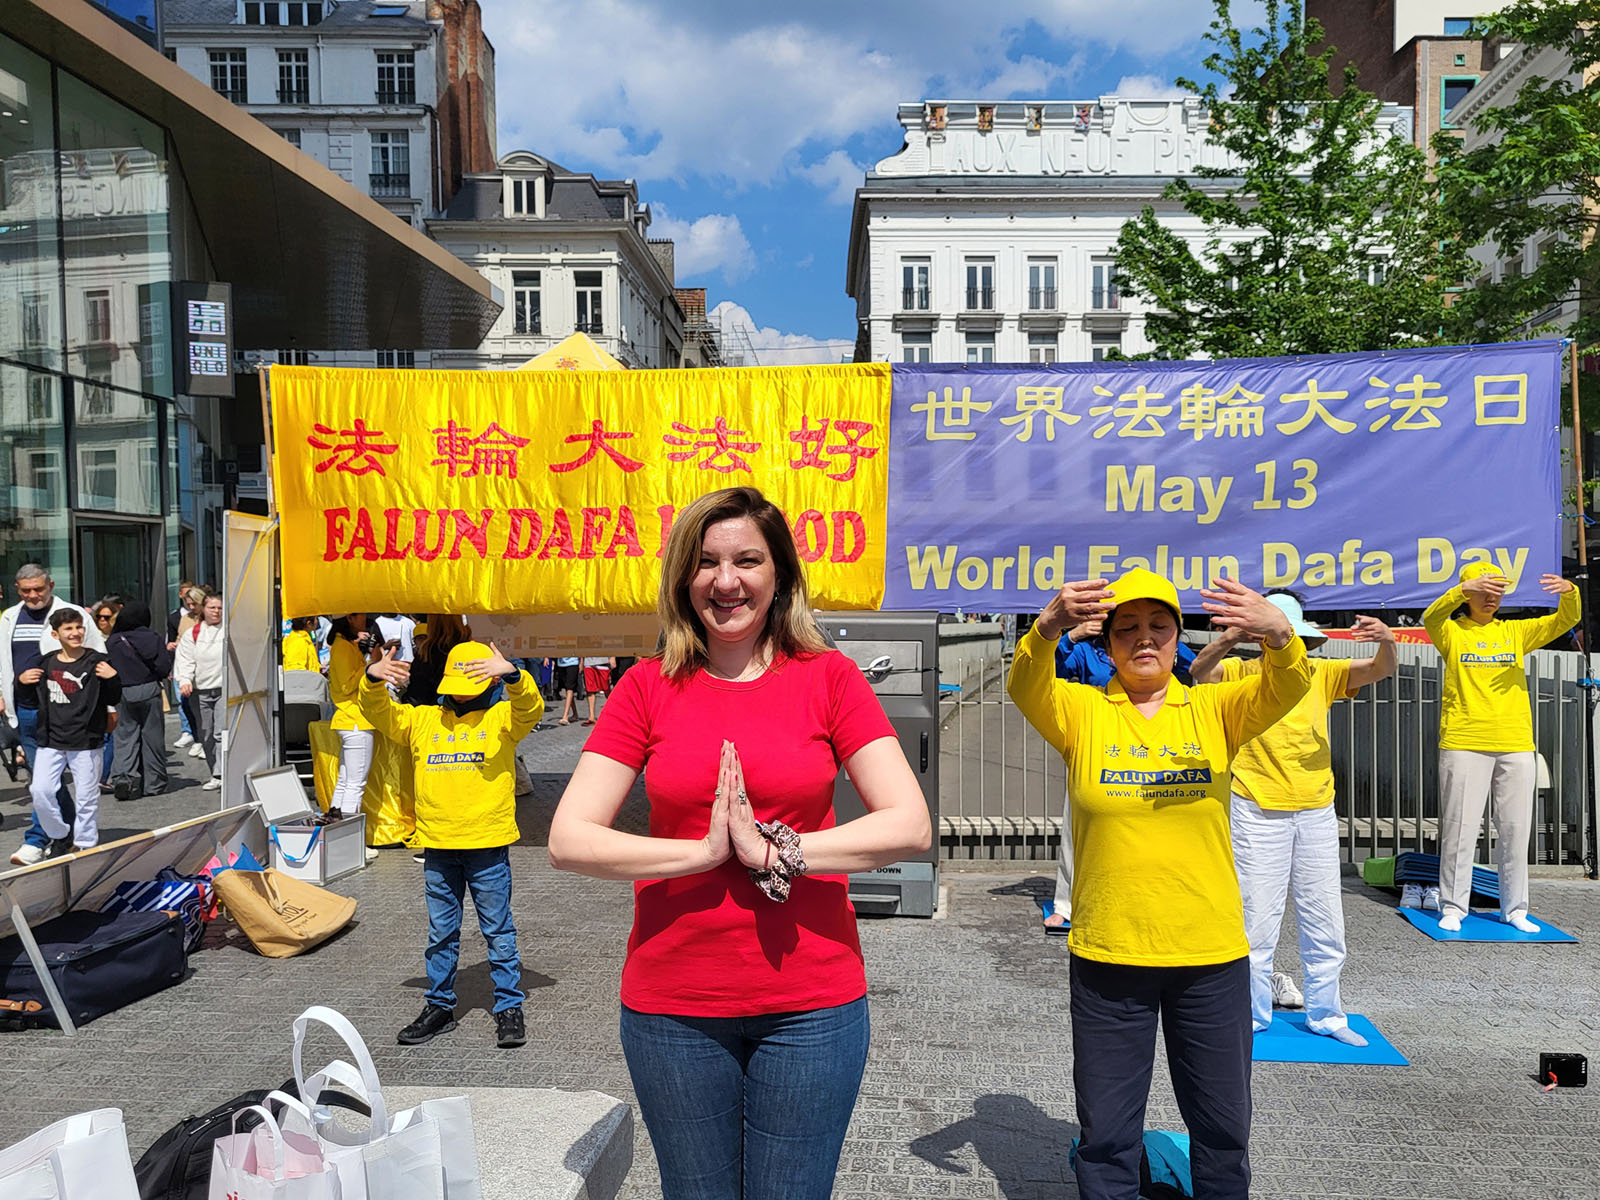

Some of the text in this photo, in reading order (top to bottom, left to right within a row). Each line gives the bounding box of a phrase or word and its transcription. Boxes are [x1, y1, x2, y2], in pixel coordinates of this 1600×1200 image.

[951, 133, 1017, 173] AUX
[1040, 133, 1131, 173] NEUF
[193, 344, 222, 358] UNI
[193, 359, 224, 374] QLO
[910, 373, 1528, 442] 世界法輪大法日
[307, 415, 879, 482] 法輪大法好
[1105, 458, 1318, 525] May 13
[323, 506, 493, 562] FALUN
[501, 505, 645, 561] DAFA
[782, 508, 868, 563] OD
[906, 545, 1064, 591] World
[1262, 540, 1394, 585] Dafa
[1418, 538, 1528, 595] Day
[430, 753, 483, 763] FALUN DAFA
[1105, 742, 1202, 758] 法輪大法
[1104, 770, 1207, 783] FALUN DAFA
[1106, 788, 1206, 798] www.falundafa.org
